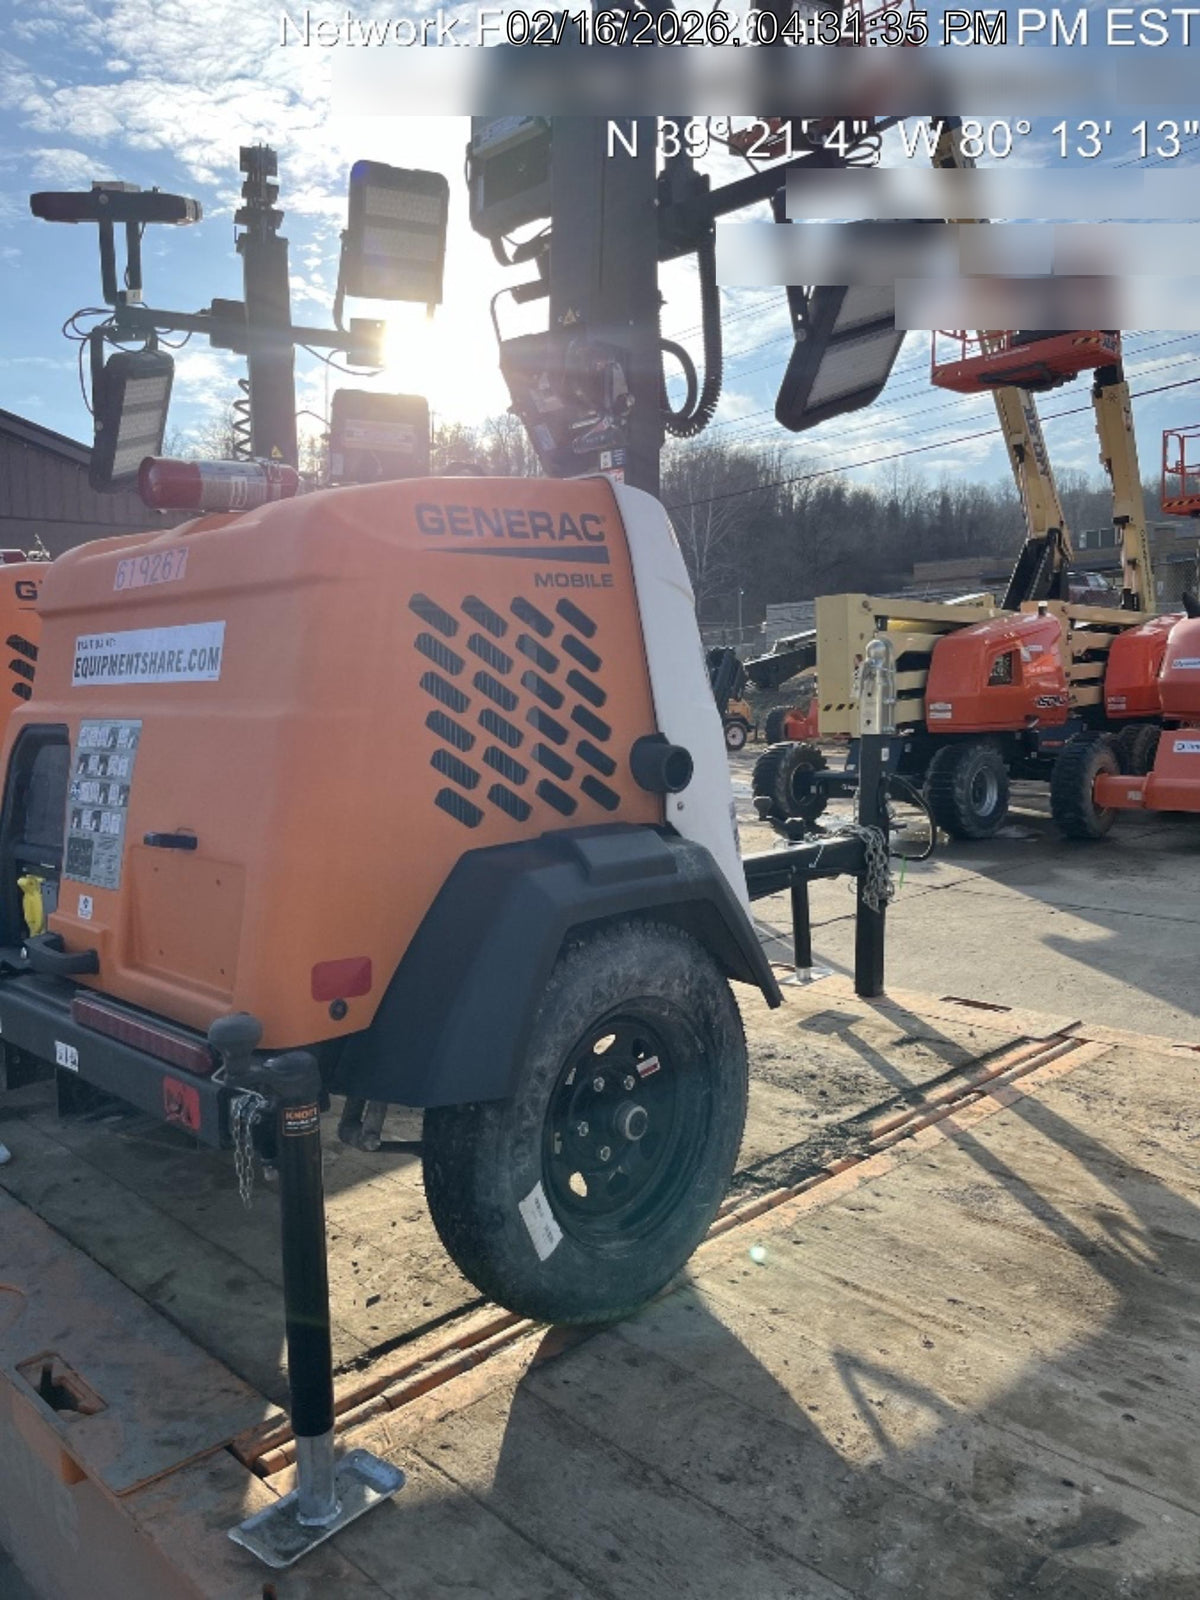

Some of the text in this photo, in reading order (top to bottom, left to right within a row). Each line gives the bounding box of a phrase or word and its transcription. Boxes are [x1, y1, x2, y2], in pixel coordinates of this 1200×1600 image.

[414, 503, 606, 542] GENERAC
[534, 573, 614, 588] MOBILE
[74, 647, 220, 678] EQUIPMENTSHARE.COM
